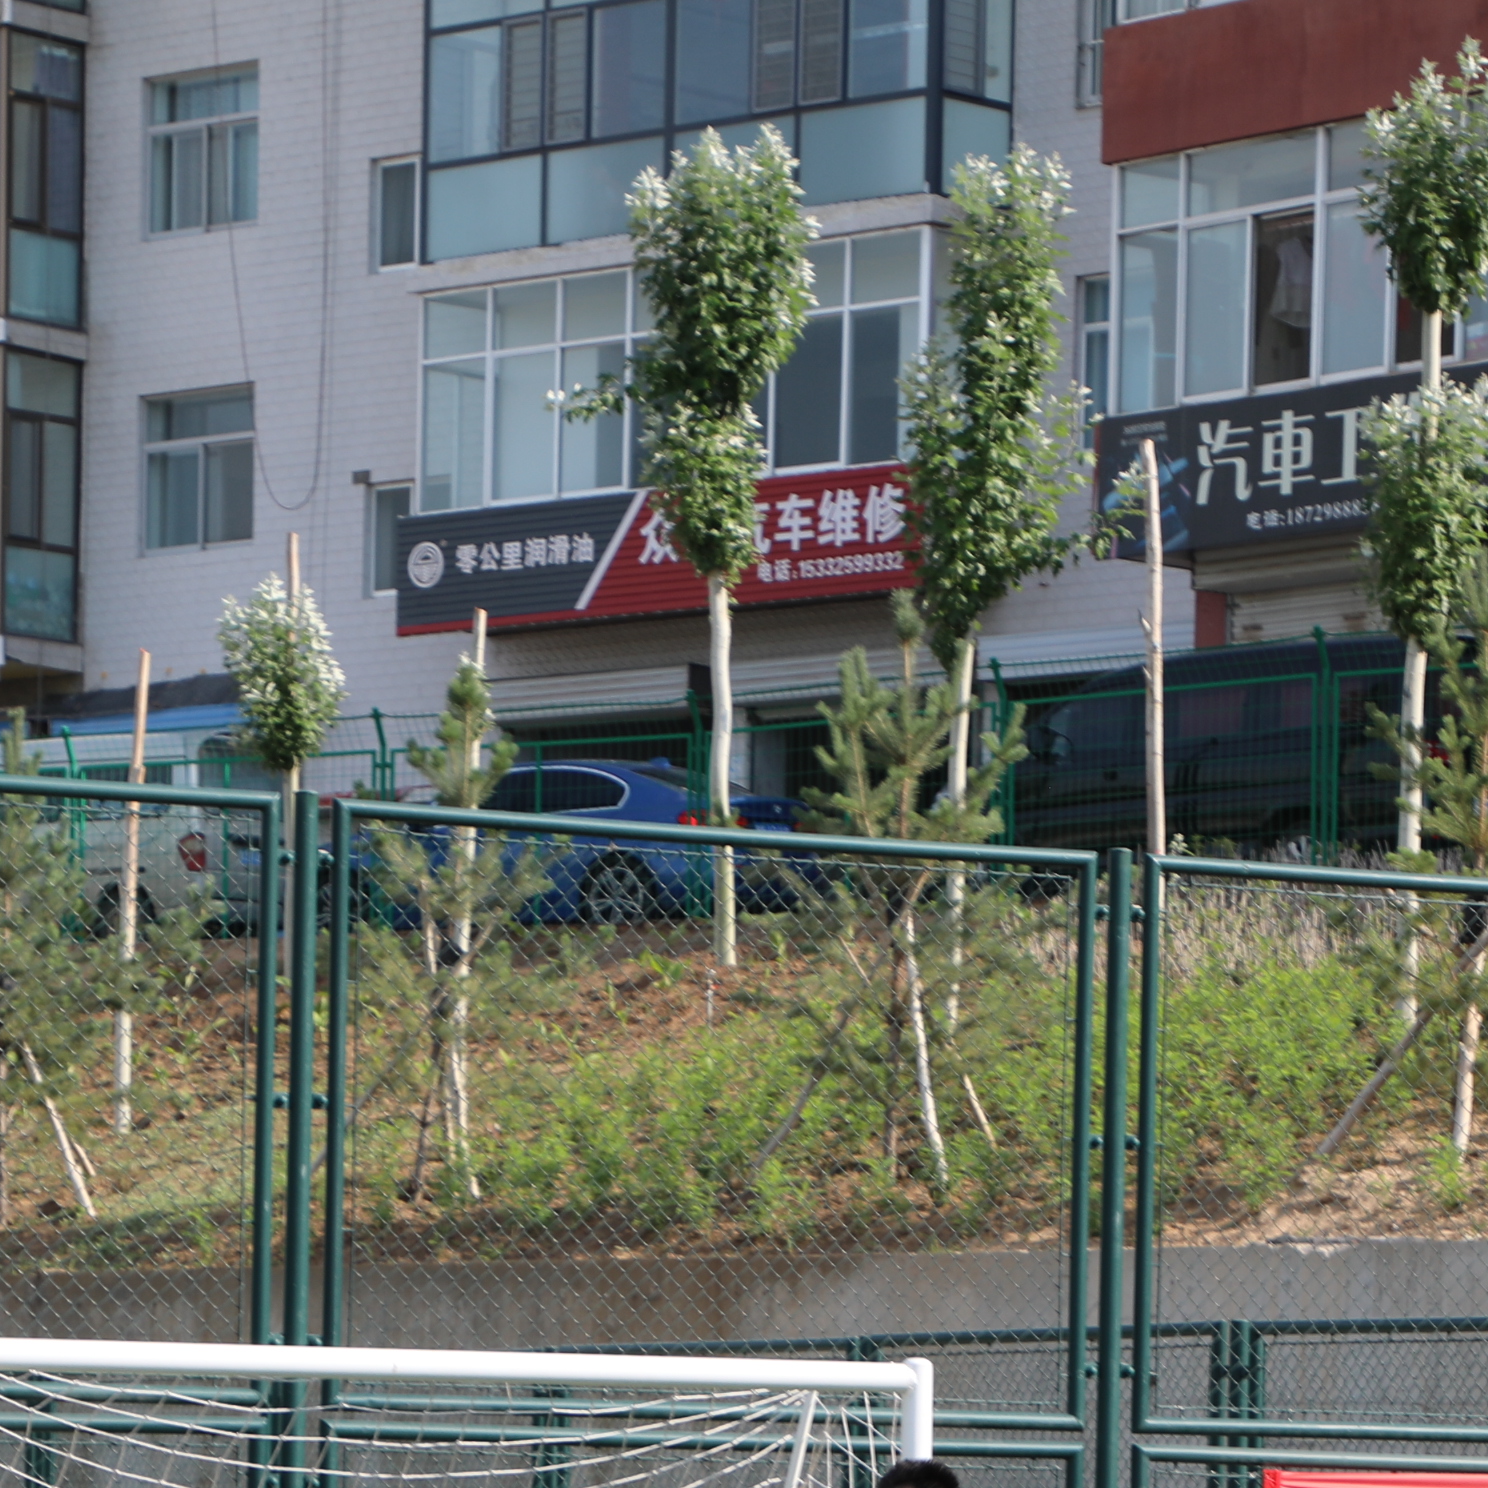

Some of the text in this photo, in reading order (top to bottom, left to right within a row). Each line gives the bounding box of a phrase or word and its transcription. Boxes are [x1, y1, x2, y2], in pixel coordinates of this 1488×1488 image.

[455, 532, 594, 574] 零公里润滑油
[638, 483, 908, 565] 众车维修
